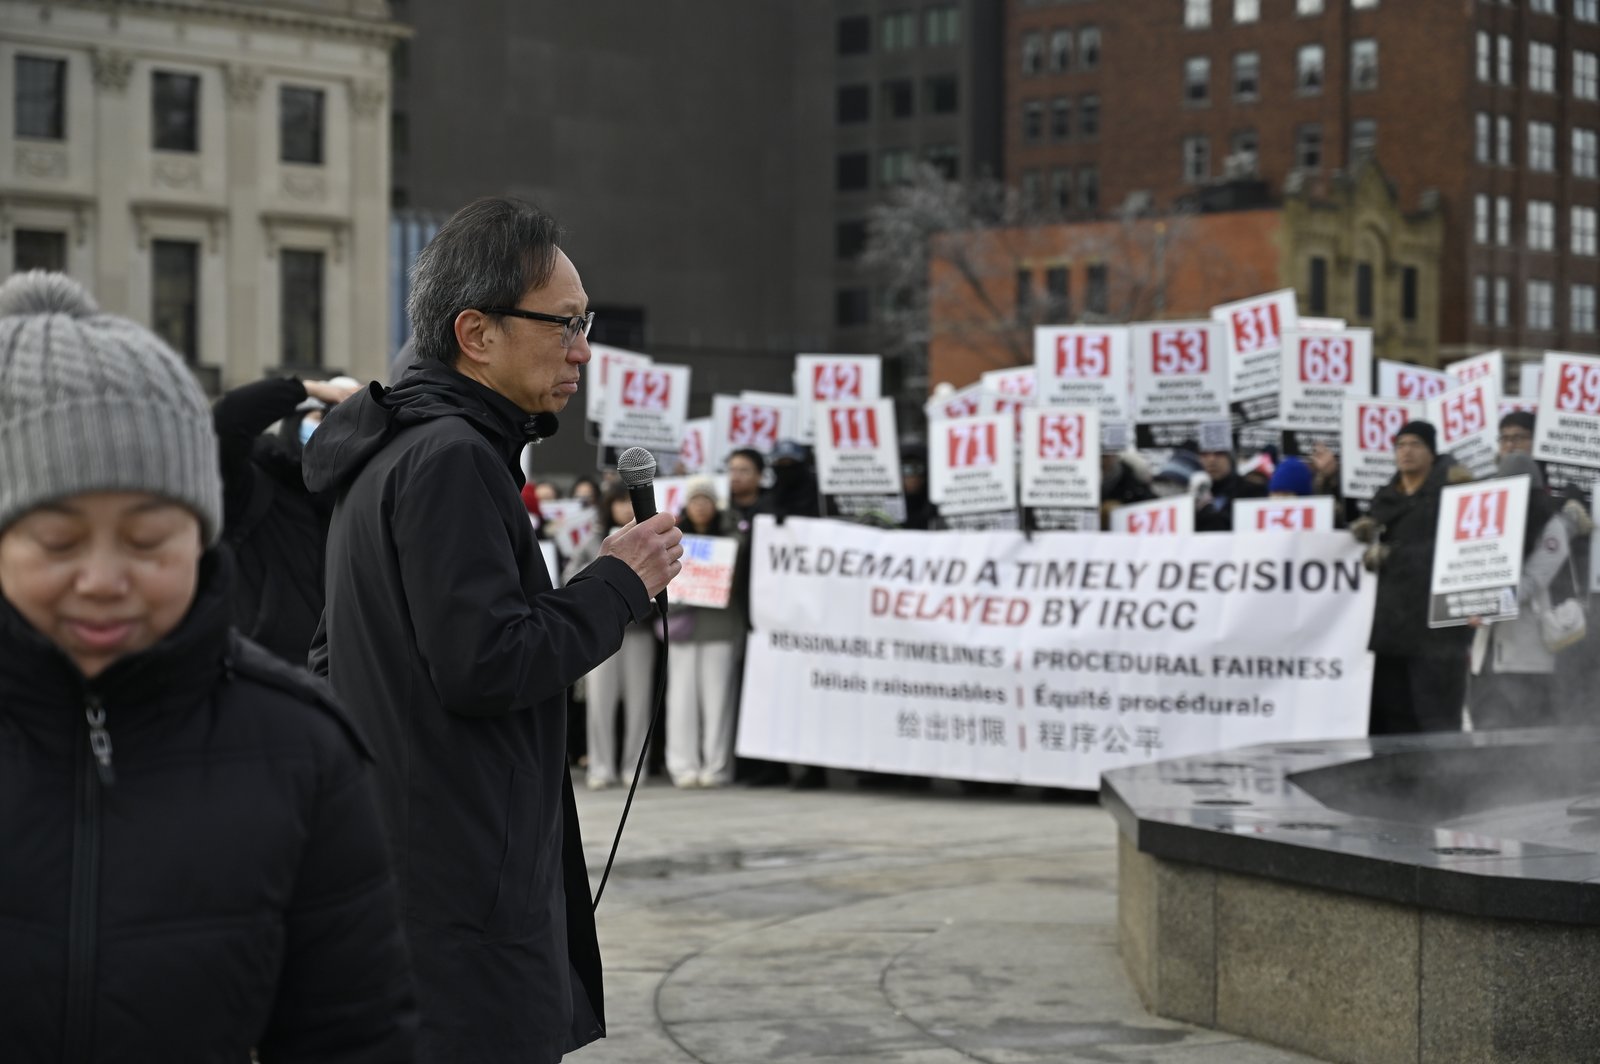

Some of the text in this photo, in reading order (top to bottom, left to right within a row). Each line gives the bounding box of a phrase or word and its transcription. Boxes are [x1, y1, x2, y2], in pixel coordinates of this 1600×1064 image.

[1232, 304, 1280, 353] 31
[1056, 335, 1110, 377] 15
[1152, 330, 1208, 373] 53
[1300, 338, 1353, 384] 68
[622, 371, 671, 410] 42
[814, 364, 861, 401] 42
[1556, 363, 1600, 414] 39
[730, 405, 779, 446] 32
[1039, 414, 1084, 459] 53
[1442, 387, 1486, 444] 55
[949, 422, 996, 468] 71
[1453, 488, 1510, 543] 41
[769, 545, 1362, 593] WE DEMAND A TIMELY DECISION
[870, 586, 1198, 631] DELAYED BY IRCC
[769, 630, 1344, 680] REASONABLE TIMELINES PROCEDURAL FAIRNESS
[872, 677, 1006, 704] raisonnables
[1034, 683, 1111, 711] Équité
[1117, 692, 1275, 718] procédurale
[1039, 721, 1163, 758] 程序公平
